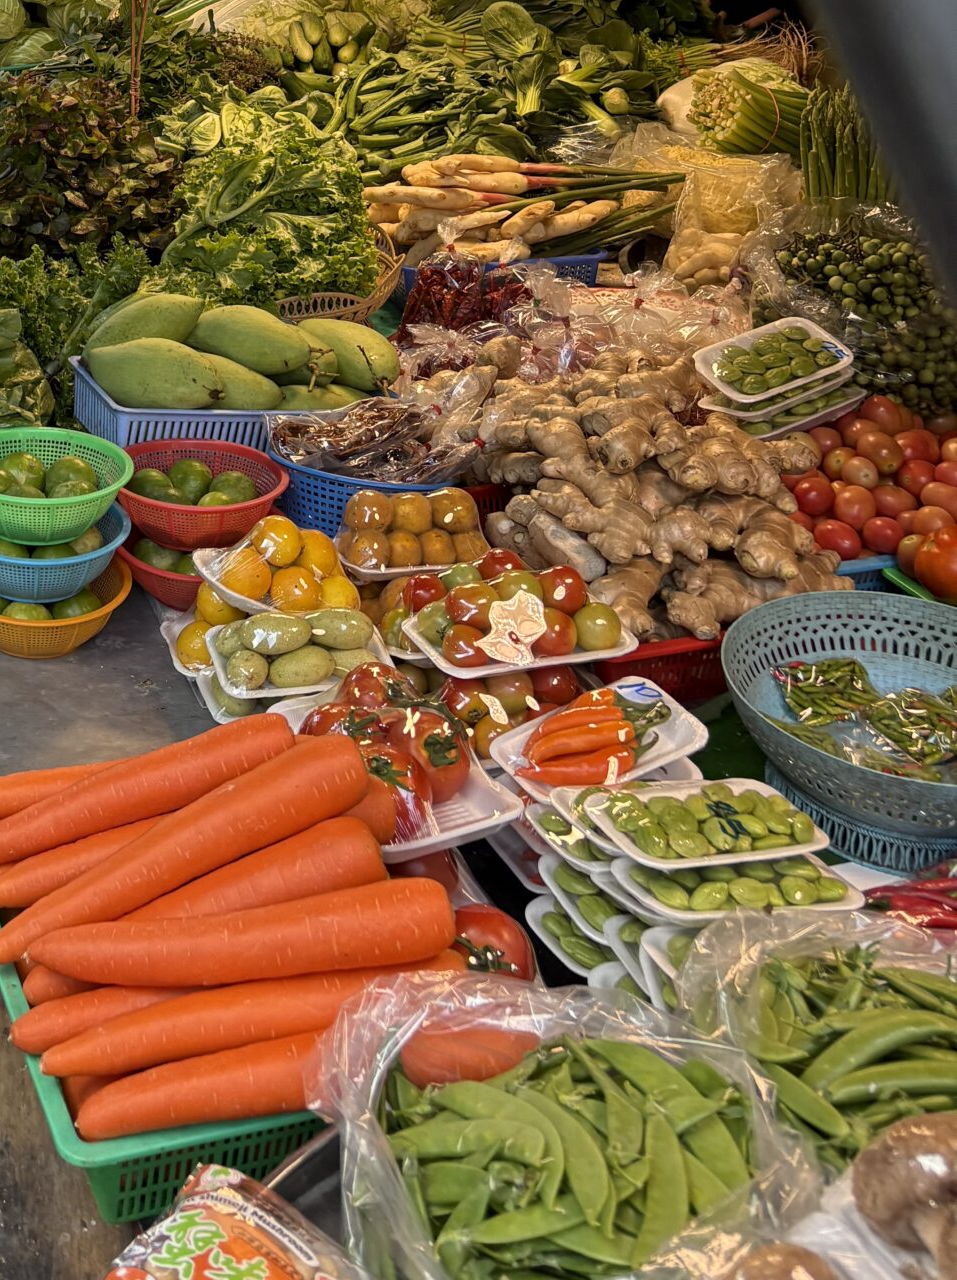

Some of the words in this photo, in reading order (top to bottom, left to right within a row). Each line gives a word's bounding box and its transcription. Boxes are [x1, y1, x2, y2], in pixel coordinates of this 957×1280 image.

[617, 682, 663, 698] 10
[200, 1193, 248, 1213] shimeji
[251, 1210, 314, 1261] Mushroom
